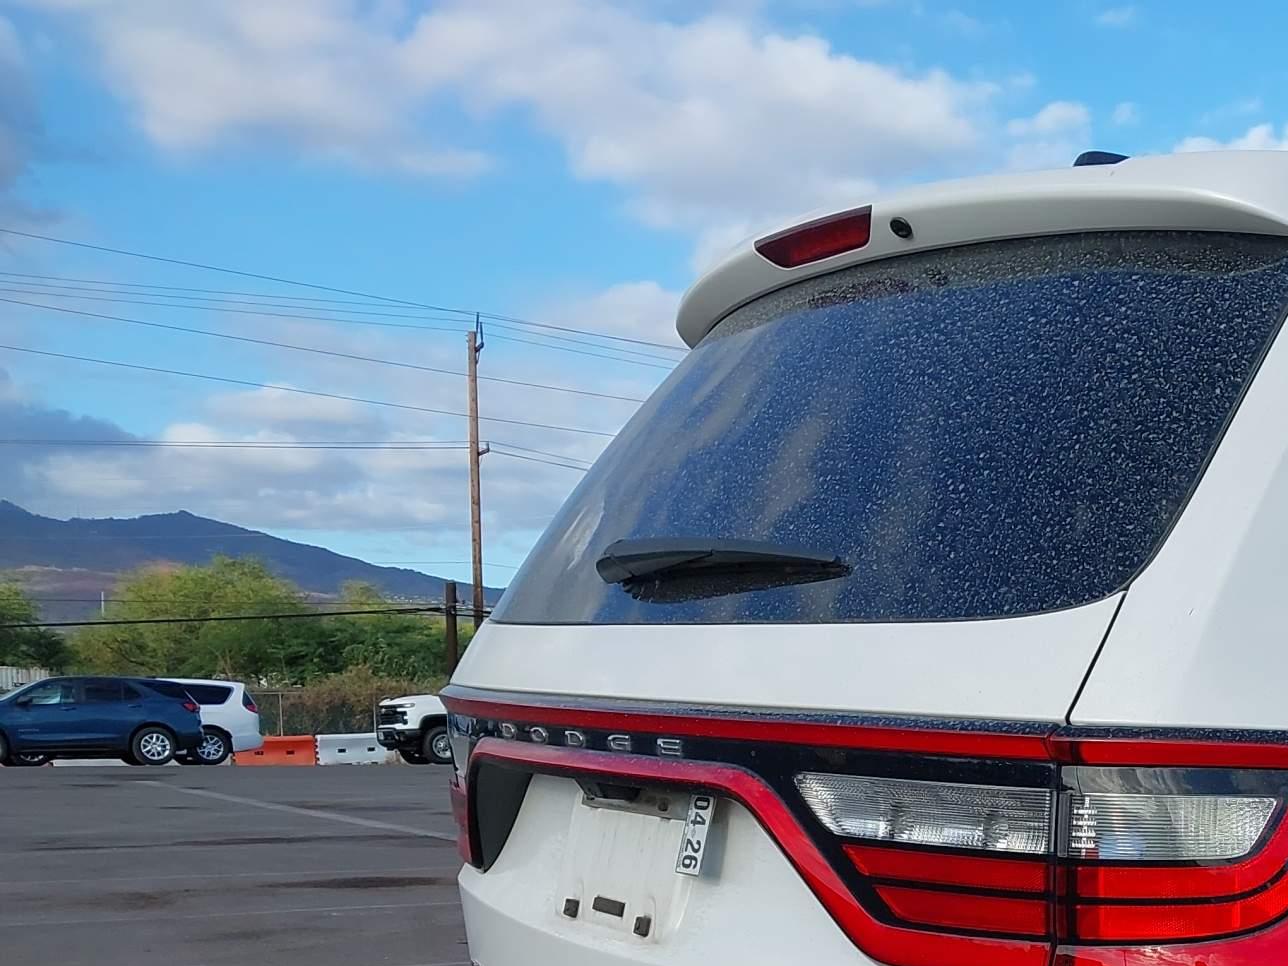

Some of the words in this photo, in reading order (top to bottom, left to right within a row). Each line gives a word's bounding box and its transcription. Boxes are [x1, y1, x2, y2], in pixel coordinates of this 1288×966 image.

[500, 722, 682, 756] DODGE
[690, 796, 711, 827] 04
[681, 838, 702, 870] 26
